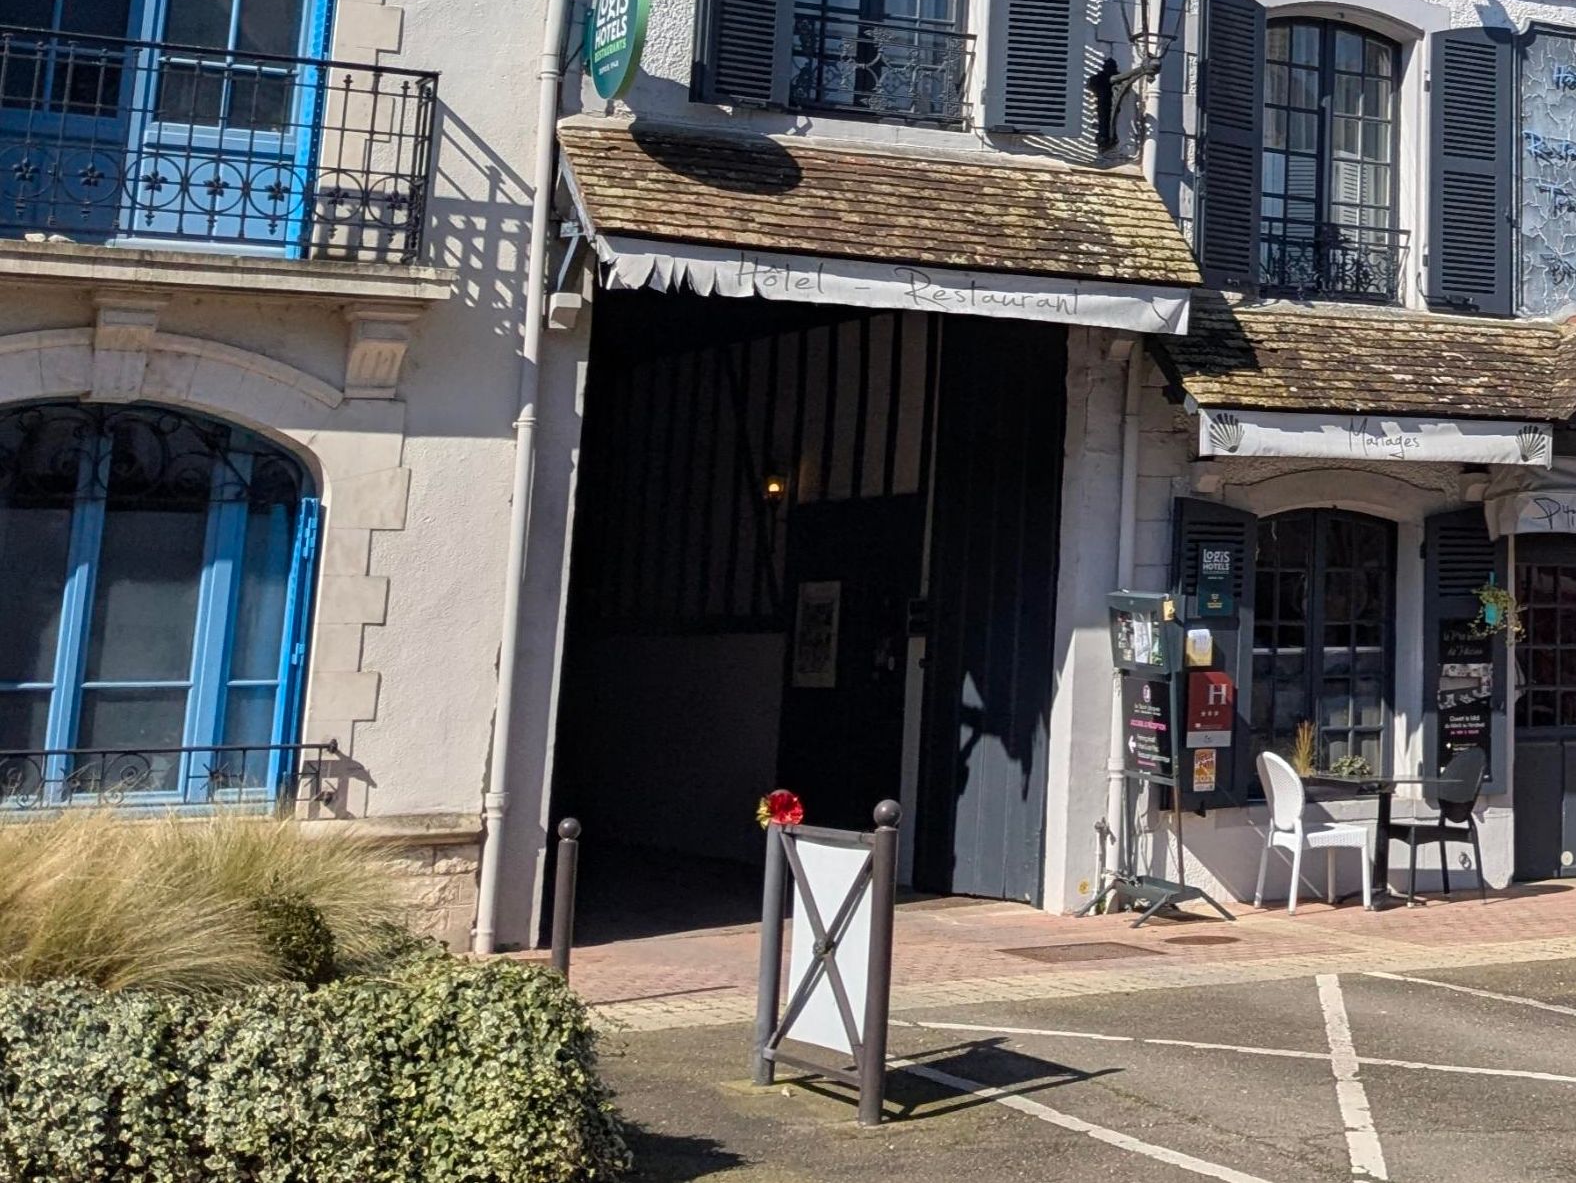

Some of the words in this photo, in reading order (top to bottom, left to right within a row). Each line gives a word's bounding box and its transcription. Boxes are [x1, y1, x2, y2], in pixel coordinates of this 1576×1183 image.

[595, 15, 627, 50] HOTELS
[735, 252, 825, 298] Hôtel
[894, 265, 1080, 316] Restaurant
[1348, 417, 1421, 459] Mariages
[1203, 563, 1230, 571] HOTELS
[1208, 683, 1227, 705] H
